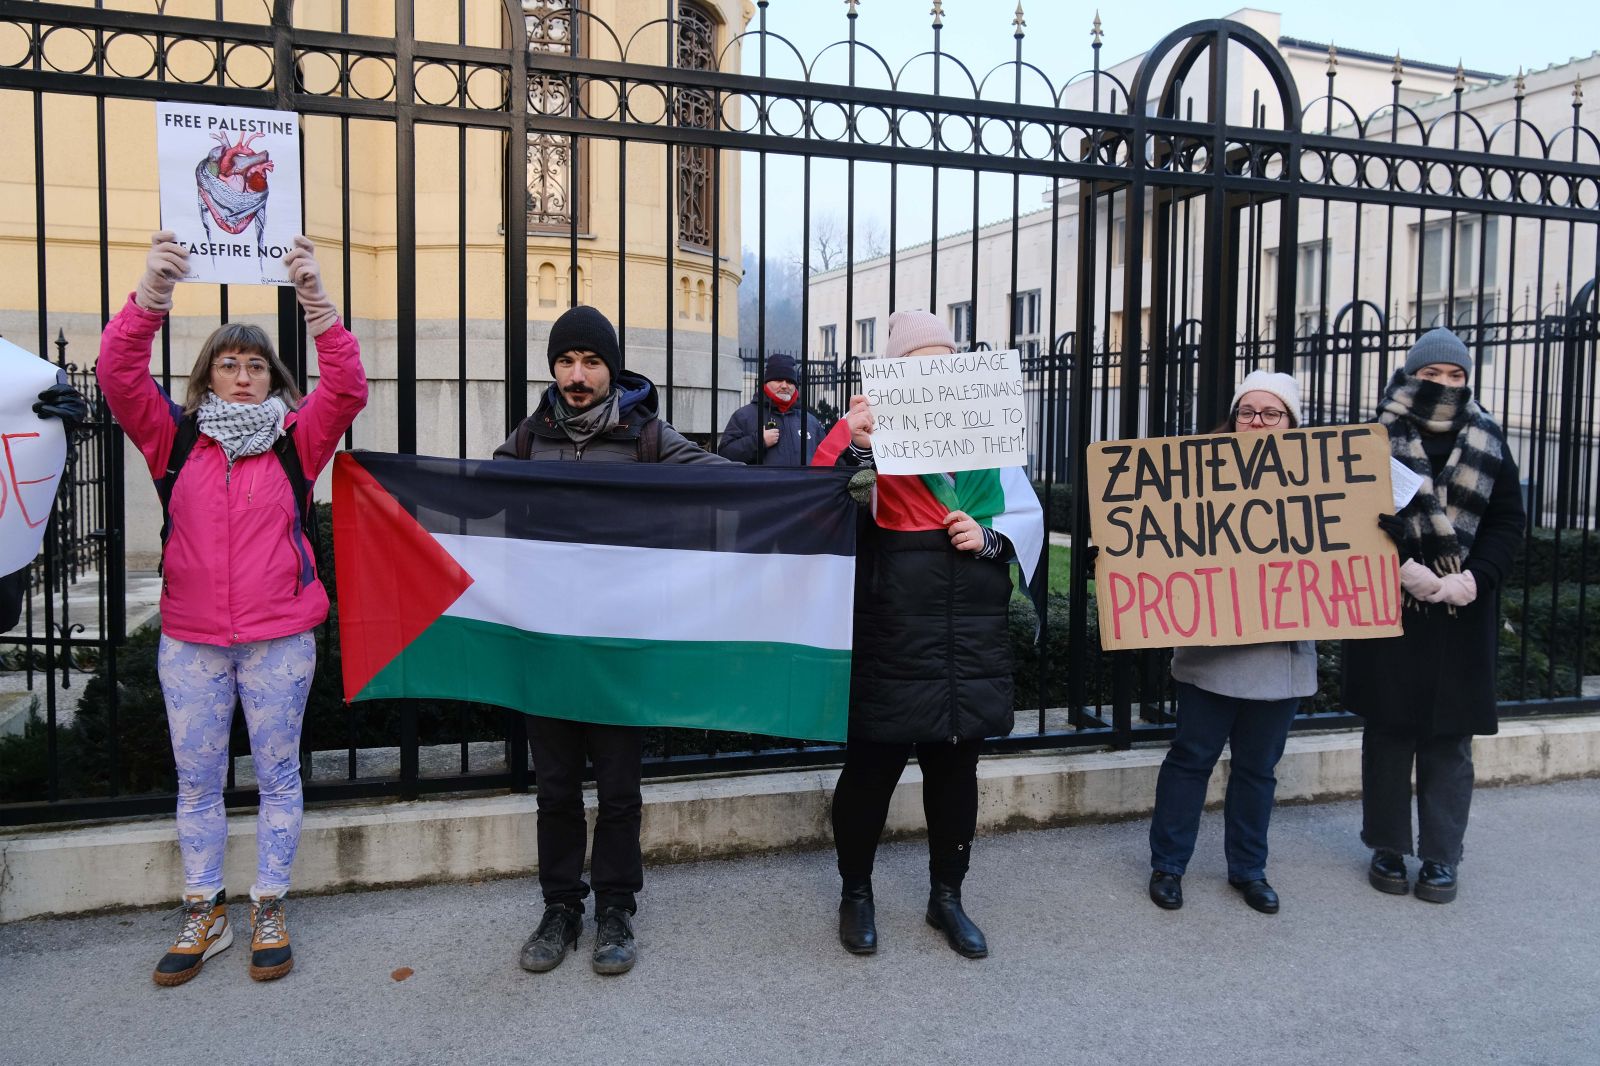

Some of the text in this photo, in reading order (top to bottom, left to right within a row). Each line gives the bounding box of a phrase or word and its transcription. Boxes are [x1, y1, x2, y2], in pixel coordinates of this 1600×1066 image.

[164, 113, 293, 136] FREE PALESTINE
[862, 352, 1010, 379] WHAT LANGUAGE
[867, 379, 1024, 407] SHOULD PALESTINIANS
[873, 408, 1023, 432] RY IN, FOR YOU TO
[873, 427, 1026, 460] UNDERSTAND THEM!
[1101, 428, 1377, 503] ZAHTEVAJTE
[1105, 493, 1351, 559] SANKCIJE
[1109, 553, 1400, 640] PROTI IZRAELU
